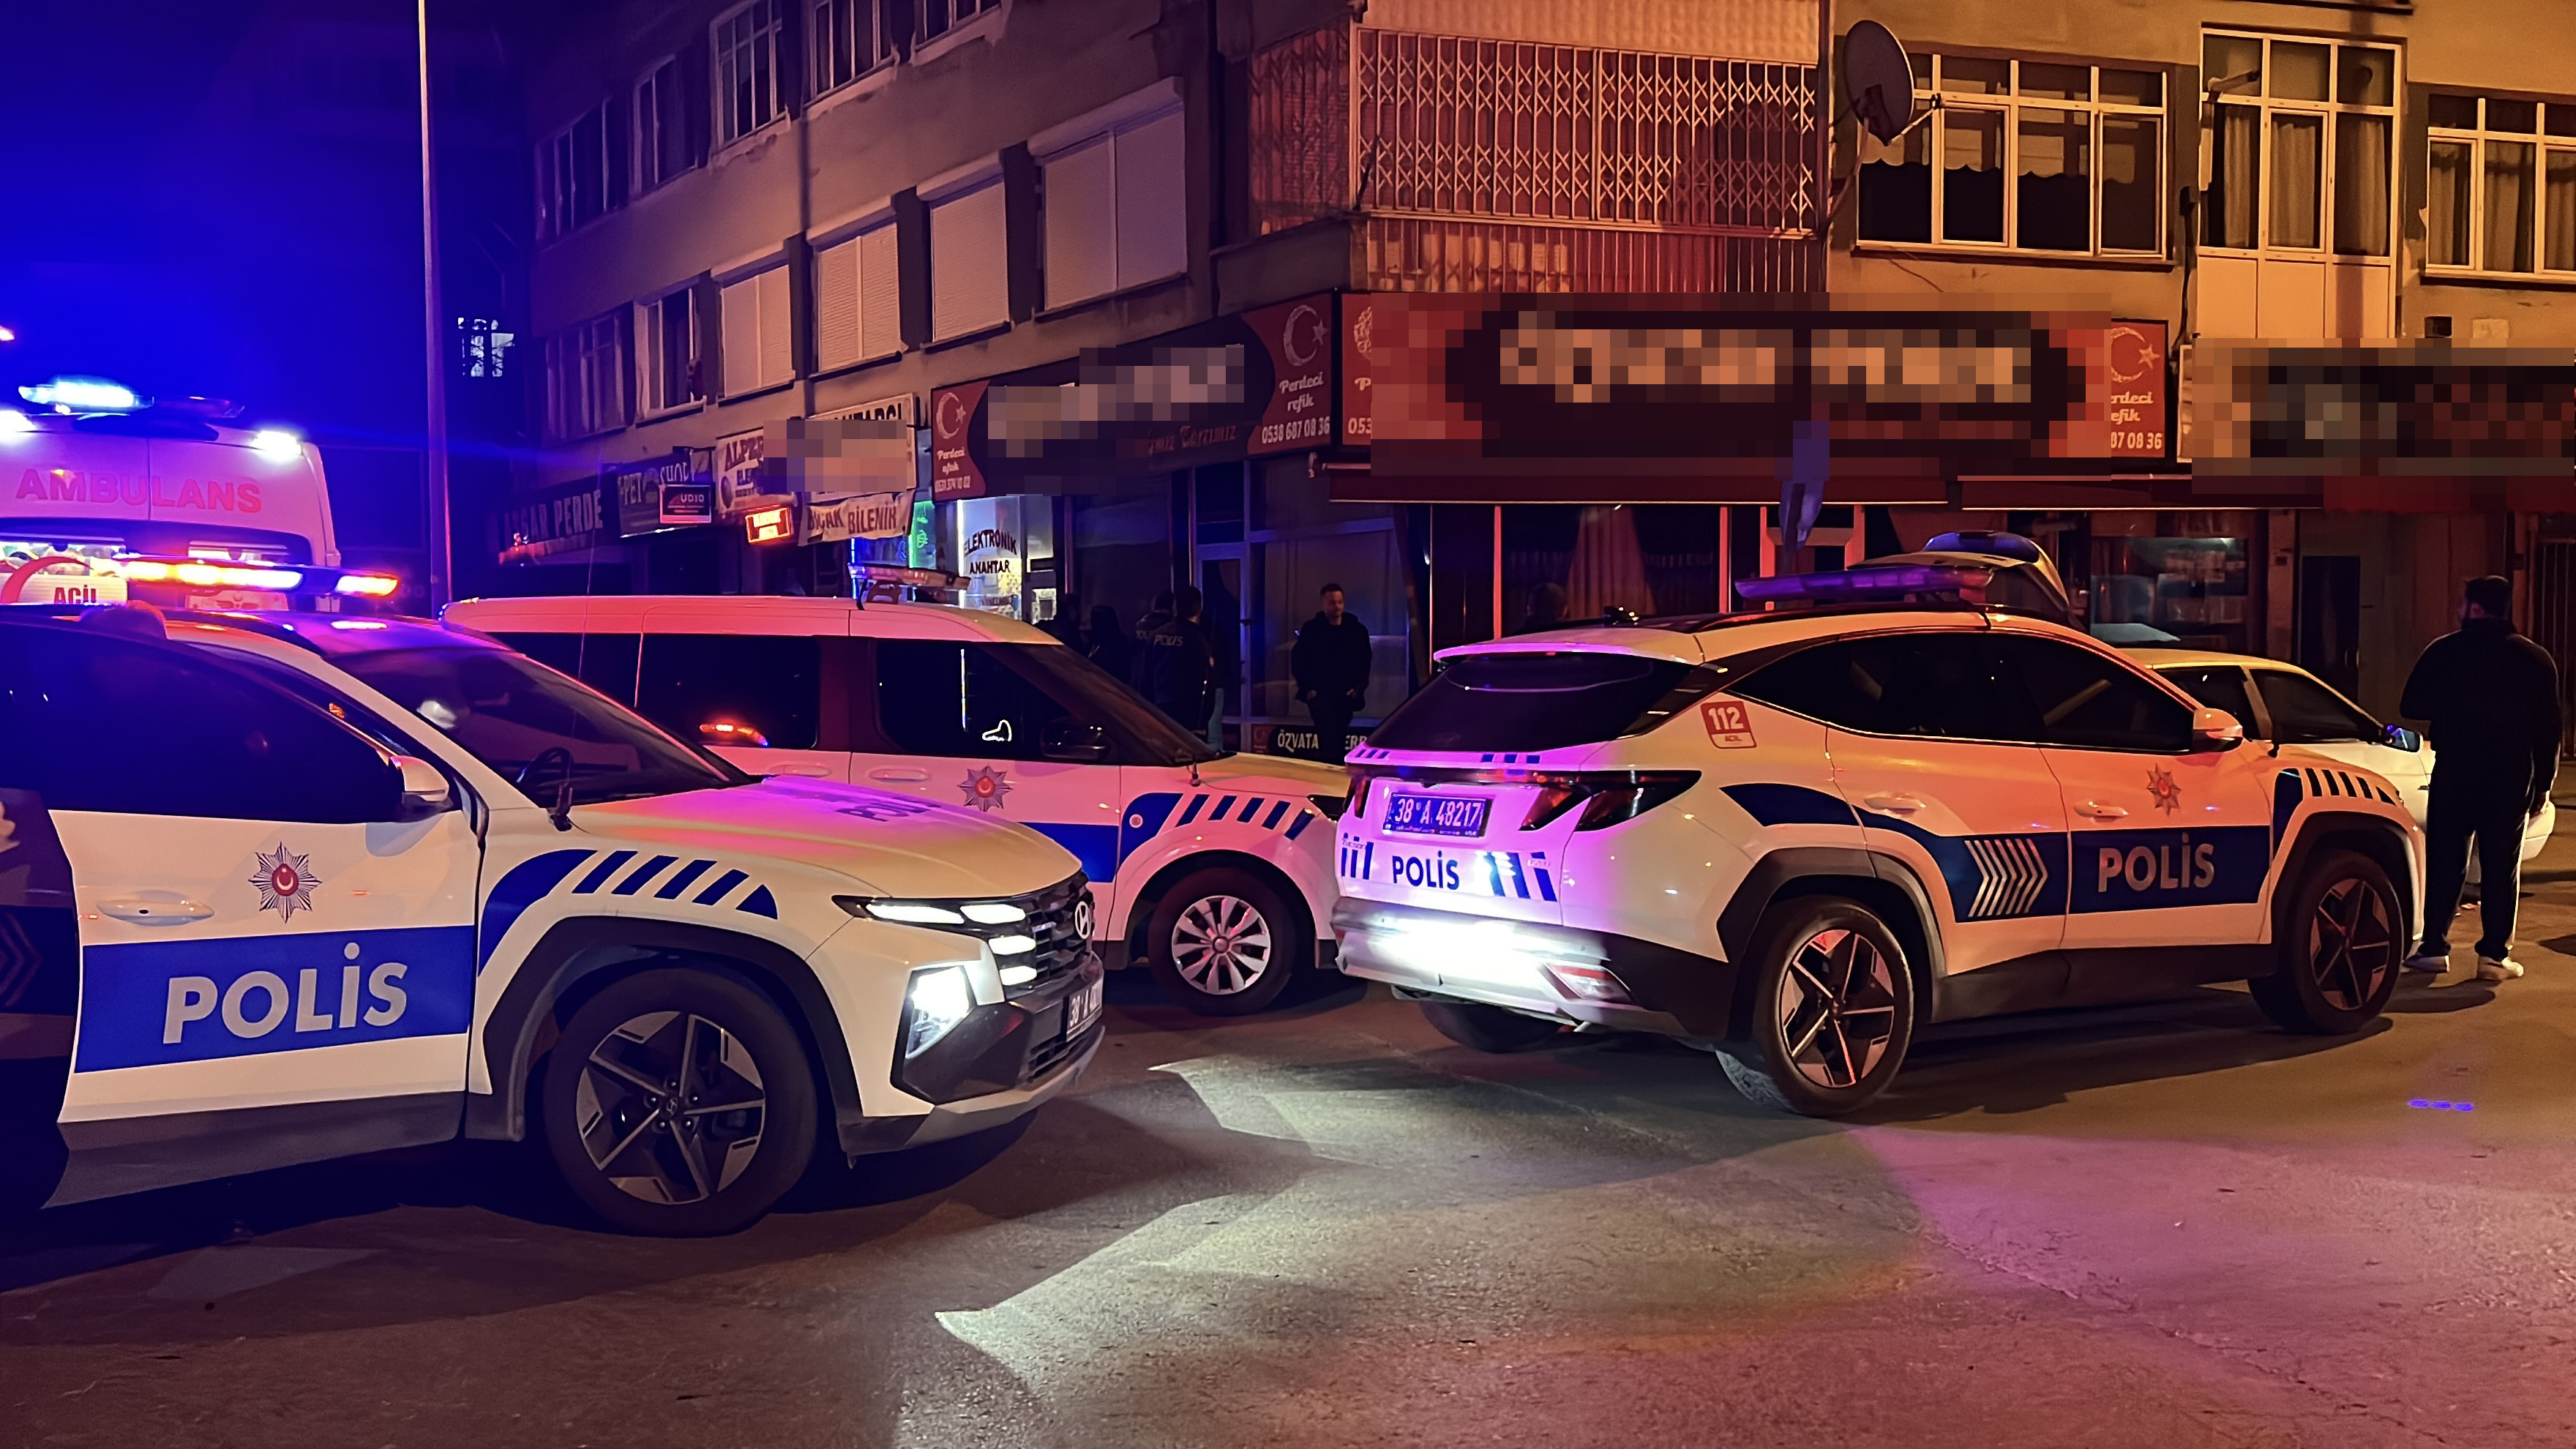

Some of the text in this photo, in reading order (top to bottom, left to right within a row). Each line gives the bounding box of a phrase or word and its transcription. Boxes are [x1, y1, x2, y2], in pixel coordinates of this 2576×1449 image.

[1278, 371, 1324, 394] Perdeci
[1287, 393, 1314, 413] refik
[2111, 391, 2154, 405] erdeci
[1348, 417, 1371, 435] 053
[2111, 408, 2141, 425] efik
[1262, 415, 1330, 444] 0538 687 08 36
[2127, 432, 2144, 449] 08
[2146, 432, 2163, 450] 36
[16, 468, 262, 513] AMBULANS
[553, 489, 603, 538] PERDE
[970, 559, 1011, 574] ANAHTAR
[1708, 706, 1745, 730] 112
[1277, 728, 1319, 753] ÖZVATA
[1394, 798, 1482, 827] 38 A 48217
[1391, 850, 1460, 891] POLİS
[2097, 831, 2215, 894] POLİS
[162, 941, 408, 1046] POLİS
